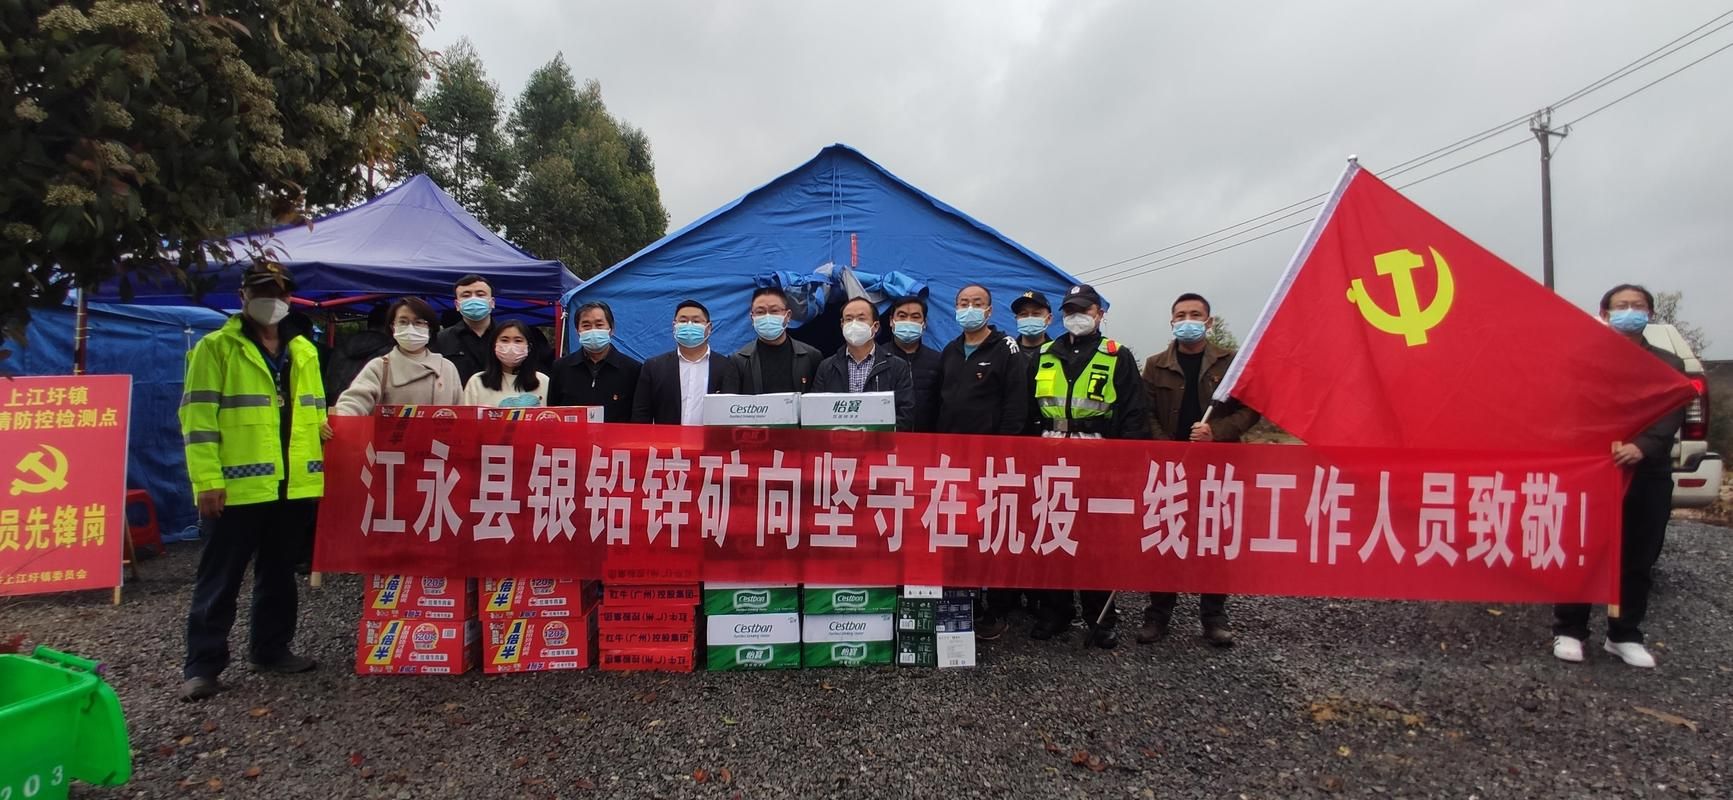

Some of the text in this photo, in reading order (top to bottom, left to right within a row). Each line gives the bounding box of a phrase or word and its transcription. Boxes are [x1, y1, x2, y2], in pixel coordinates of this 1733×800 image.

[4, 387, 88, 406] 上江圩镇
[0, 503, 106, 550] 员先锋岗
